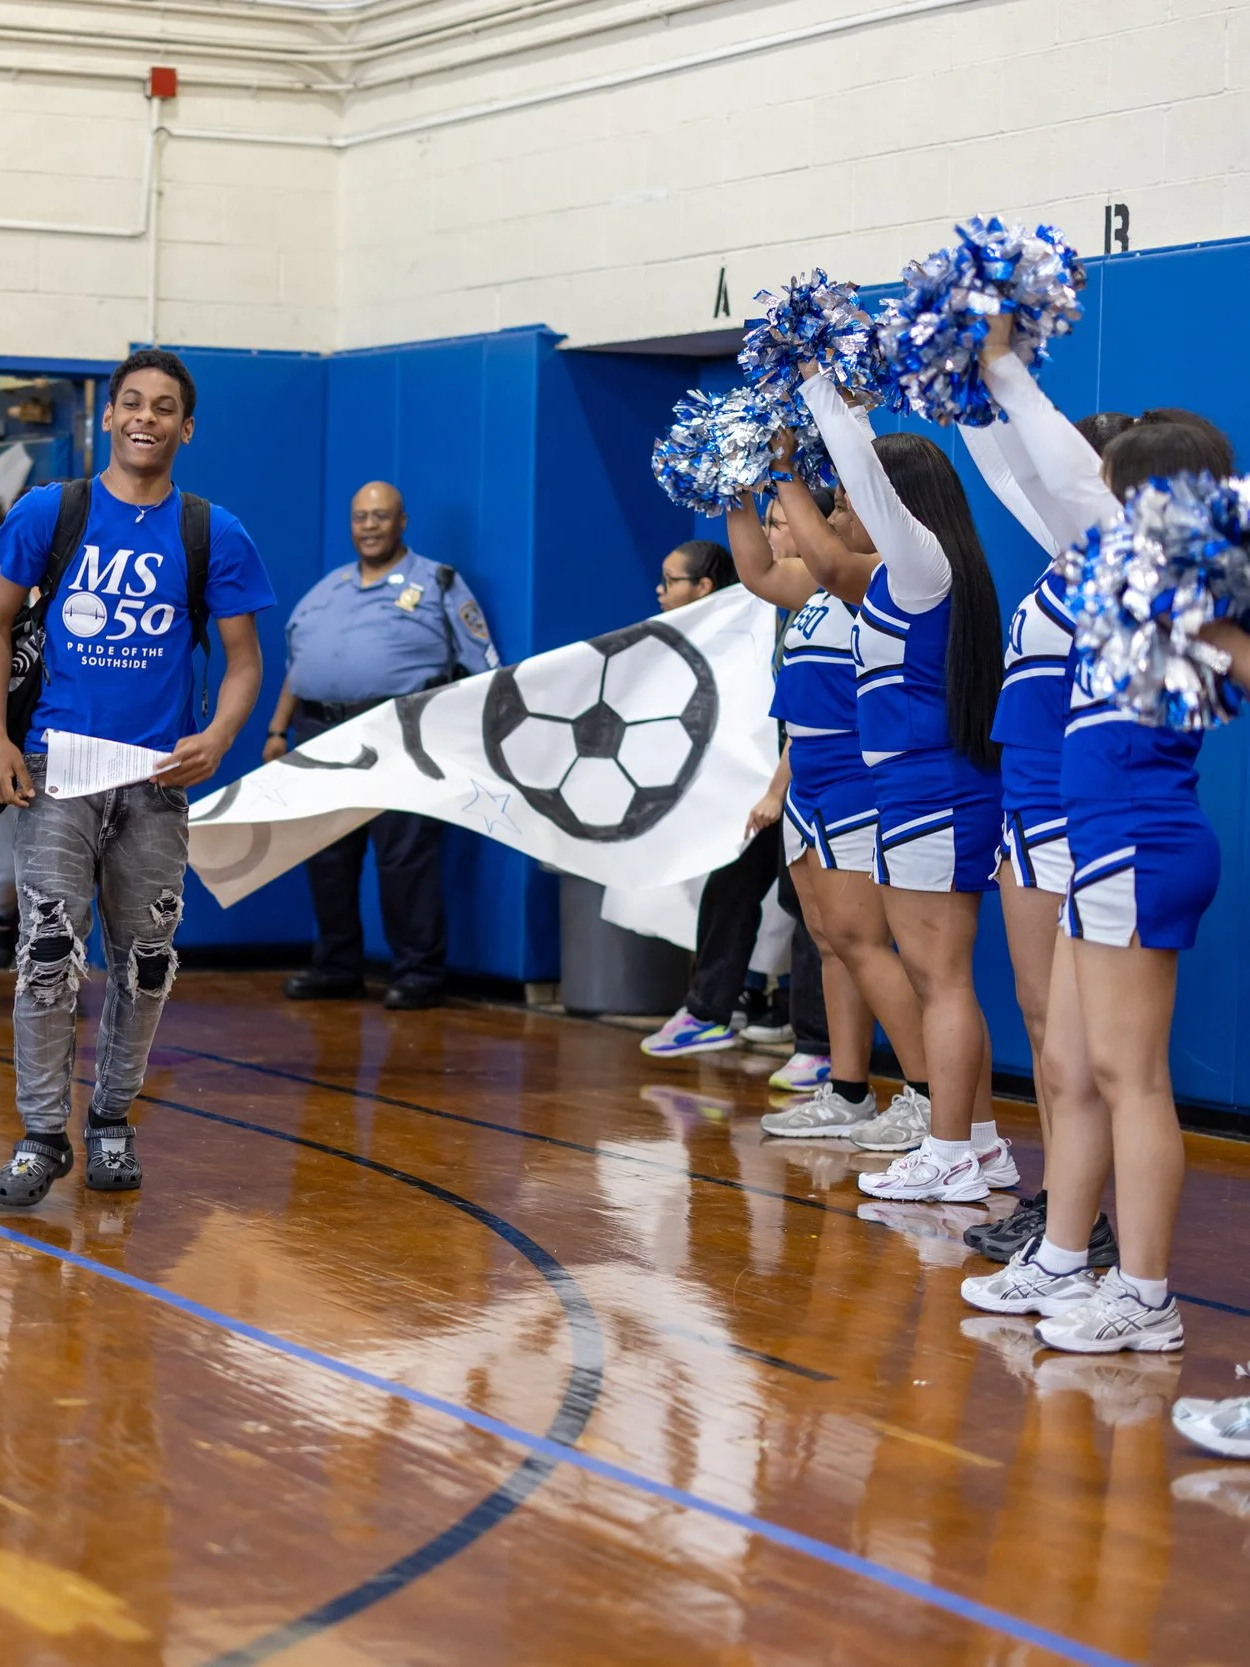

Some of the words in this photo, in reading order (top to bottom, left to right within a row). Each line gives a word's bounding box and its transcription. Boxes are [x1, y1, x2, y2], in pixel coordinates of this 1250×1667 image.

[713, 267, 730, 318] A
[68, 544, 164, 598] MS
[105, 598, 175, 641] 50
[66, 641, 115, 656] PRIDE
[121, 646, 138, 657] OF
[141, 647, 164, 657] THE
[81, 656, 147, 669] SOUTHSIDE
